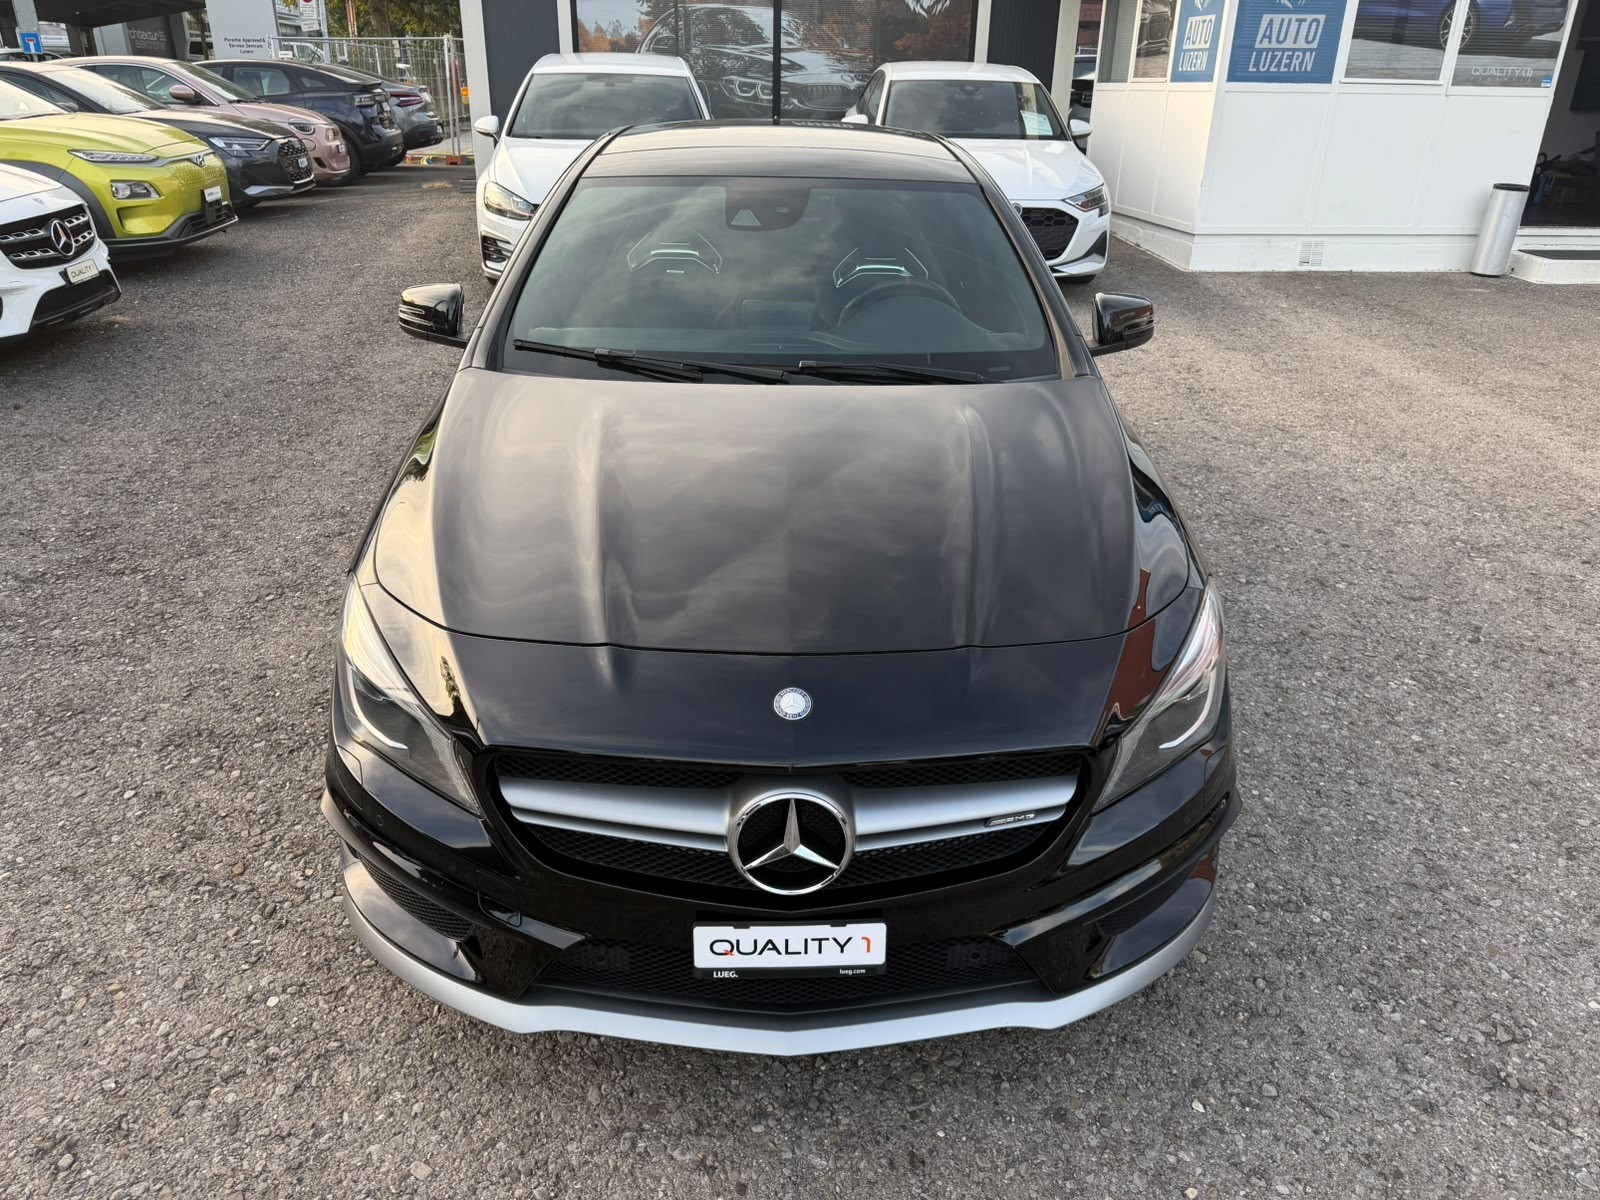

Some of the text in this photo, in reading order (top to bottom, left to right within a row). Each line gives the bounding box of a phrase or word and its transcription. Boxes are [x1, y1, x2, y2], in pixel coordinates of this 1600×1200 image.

[1185, 19, 1213, 45] AUTO
[1259, 18, 1320, 44] AUTO
[1178, 51, 1208, 71] LUZERN
[1248, 51, 1316, 71] LUZERN
[1472, 66, 1521, 76] QUALITY
[709, 937, 871, 956] QUALITY 1
